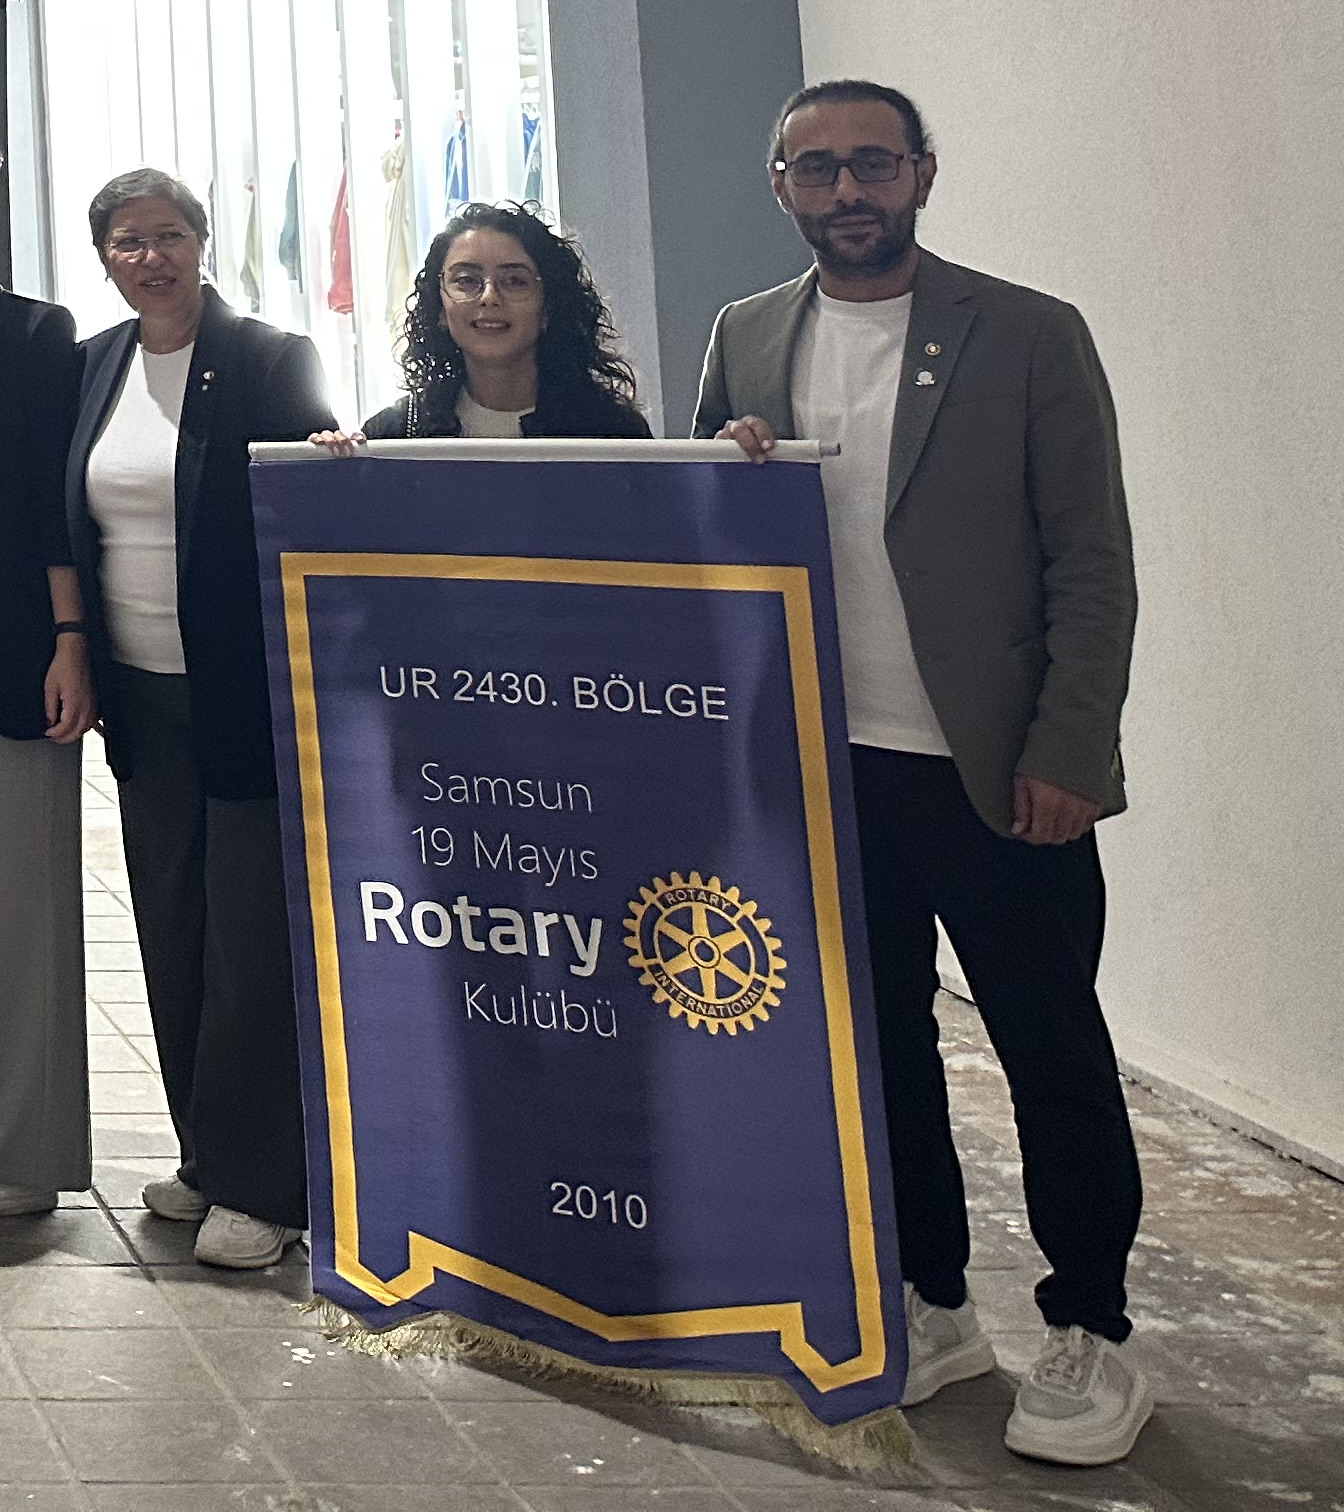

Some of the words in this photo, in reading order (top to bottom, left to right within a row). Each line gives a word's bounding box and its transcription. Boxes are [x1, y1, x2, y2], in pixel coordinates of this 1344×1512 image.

[381, 667, 439, 699] UR
[454, 670, 557, 706] 2430.
[574, 674, 729, 720] BÖLGE
[422, 763, 591, 812] Samsun
[412, 826, 453, 865] 19
[474, 831, 597, 886] Mayıs
[665, 889, 732, 912] ROTARY
[360, 880, 602, 976] Rotary
[465, 982, 616, 1037] Kulübü
[655, 972, 764, 1017] INTERNATIONAL
[551, 1182, 646, 1228] 2010
